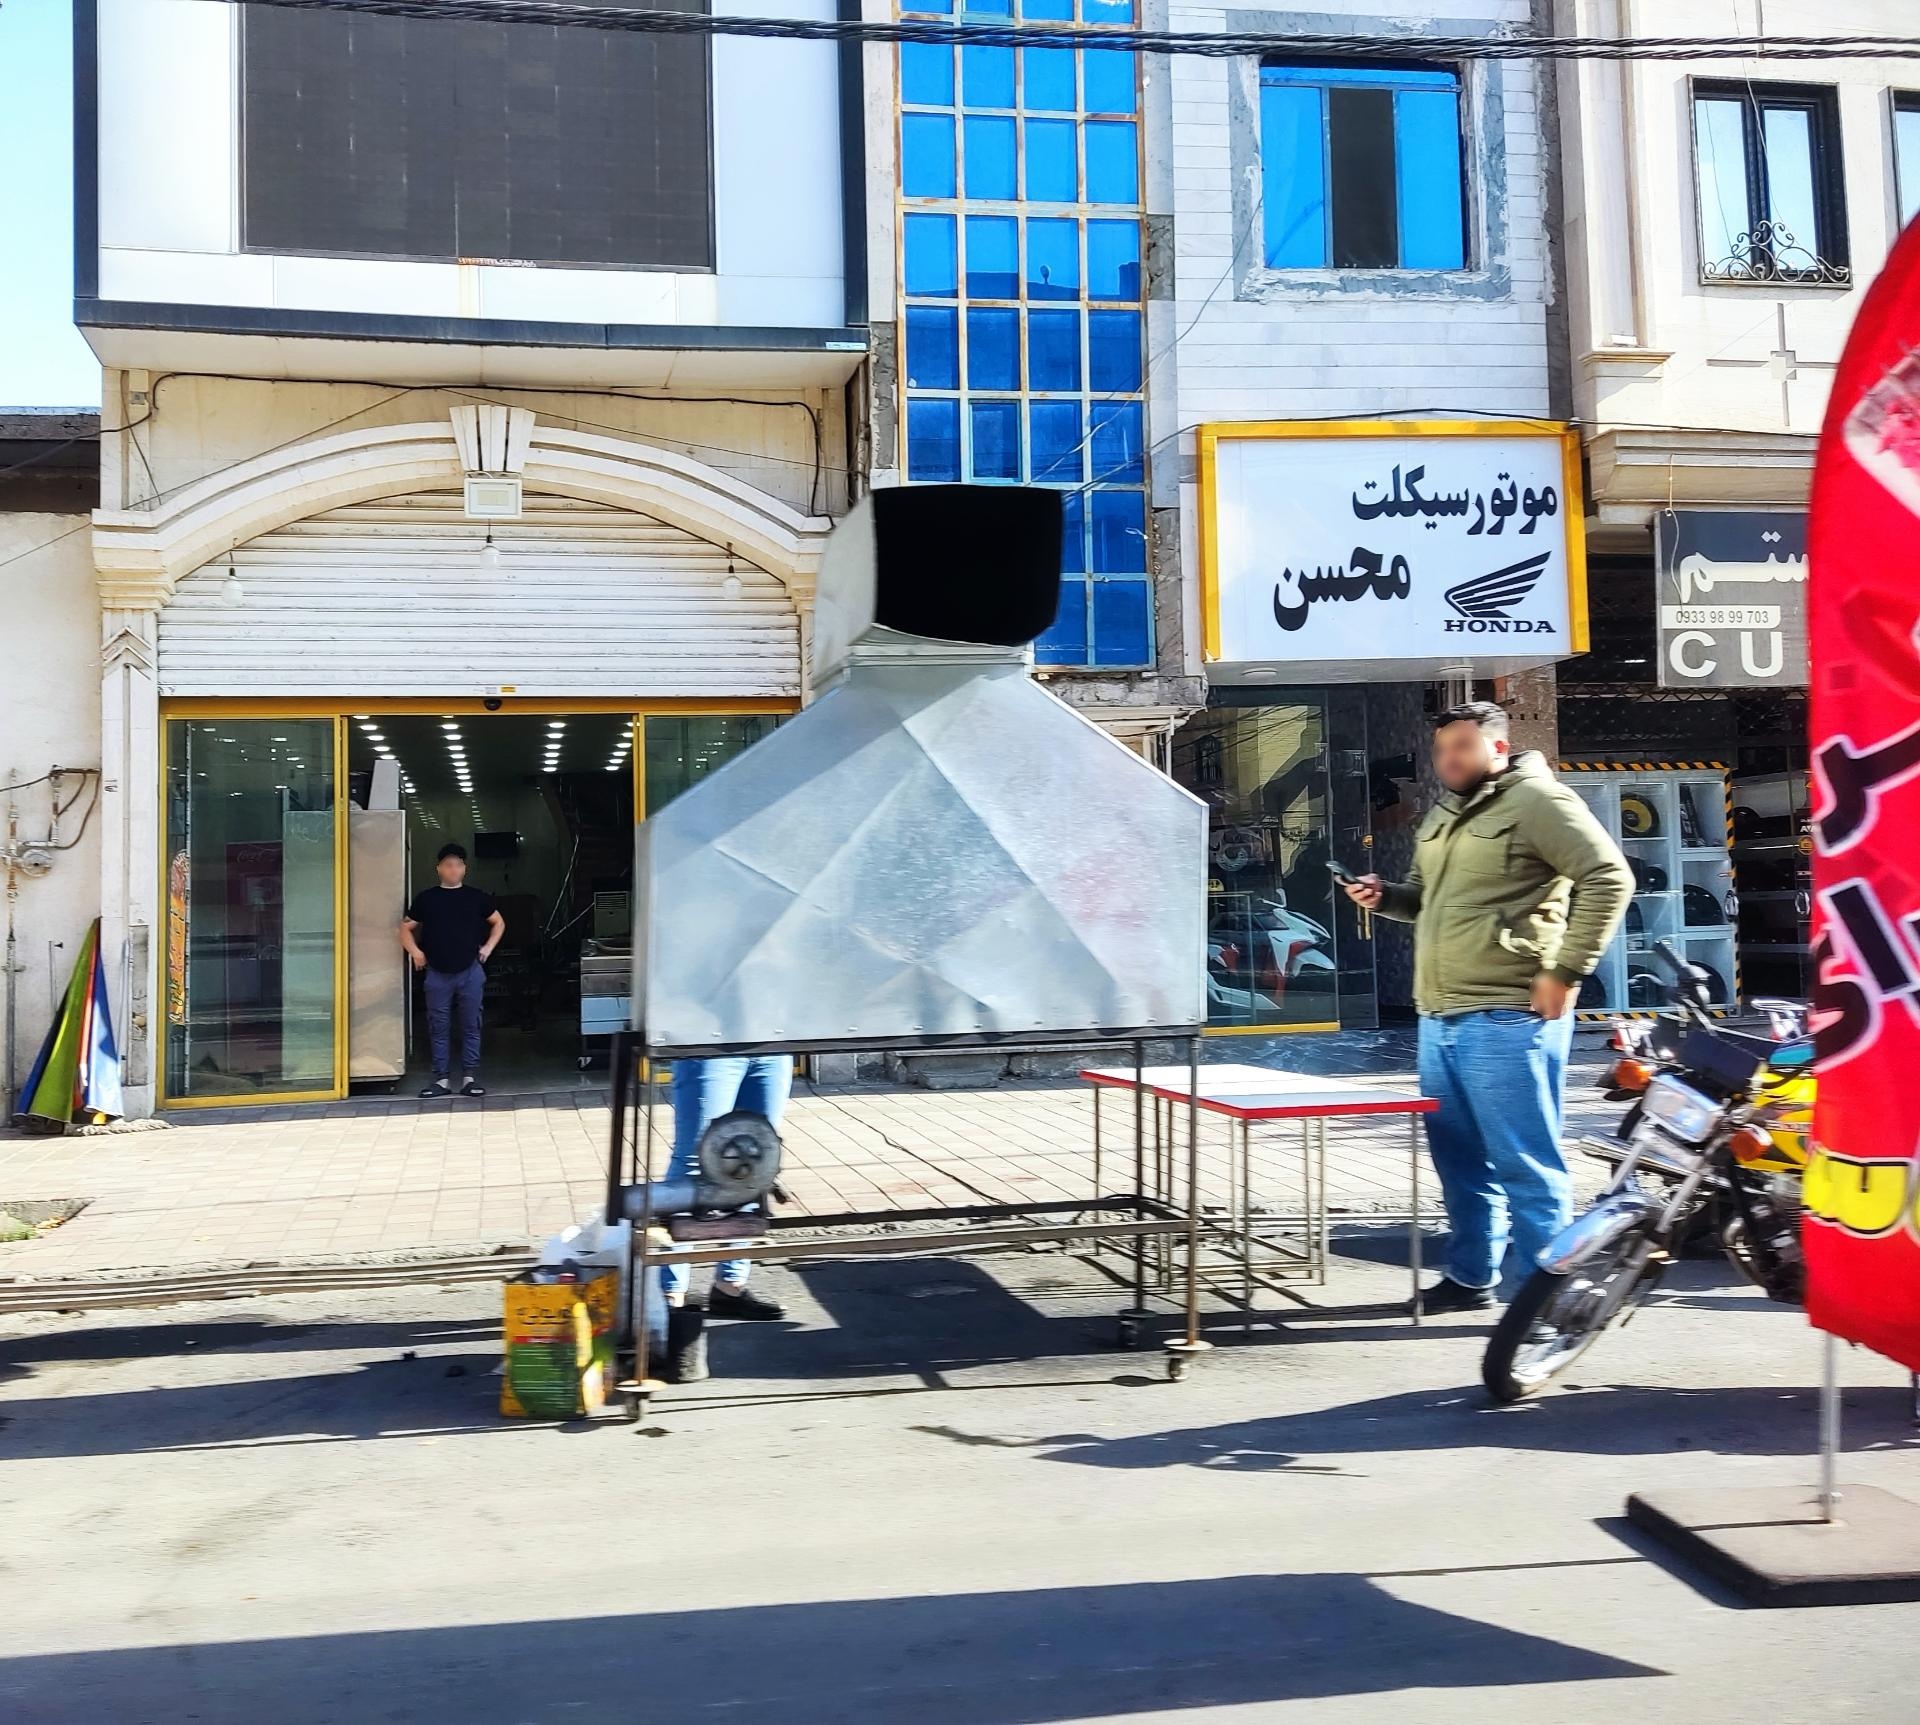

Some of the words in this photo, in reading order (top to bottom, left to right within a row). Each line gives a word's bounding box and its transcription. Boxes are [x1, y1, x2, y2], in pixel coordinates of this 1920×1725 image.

[1273, 546, 1411, 632] محسن
[1443, 620, 1557, 634] HONDA
[1675, 610, 1706, 624] 0933
[1709, 610, 1725, 624] 98
[1728, 610, 1743, 624] 99
[1747, 610, 1769, 624] 703
[1669, 630, 1811, 678] CU
